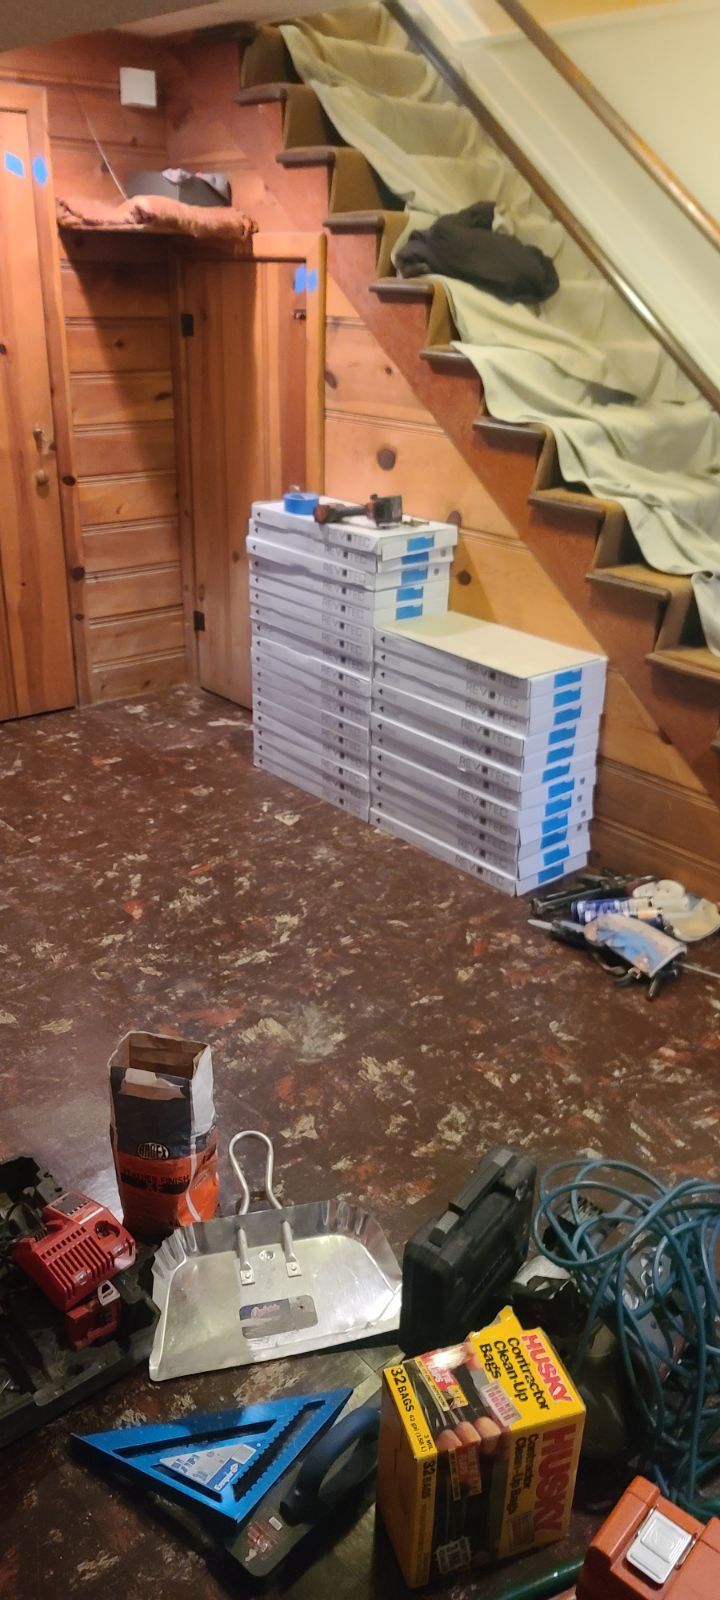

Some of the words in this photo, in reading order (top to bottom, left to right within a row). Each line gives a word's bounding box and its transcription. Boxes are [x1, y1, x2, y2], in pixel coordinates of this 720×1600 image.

[391, 1368, 407, 1385] 32
[479, 1343, 502, 1379] Bags
[493, 1340, 528, 1402] Clean-Up
[507, 1337, 550, 1410] Contractor
[521, 1334, 573, 1403] HUSKY
[397, 1385, 415, 1412] BAGS
[423, 1460, 436, 1474] 32
[533, 1423, 577, 1531] HUSKY
